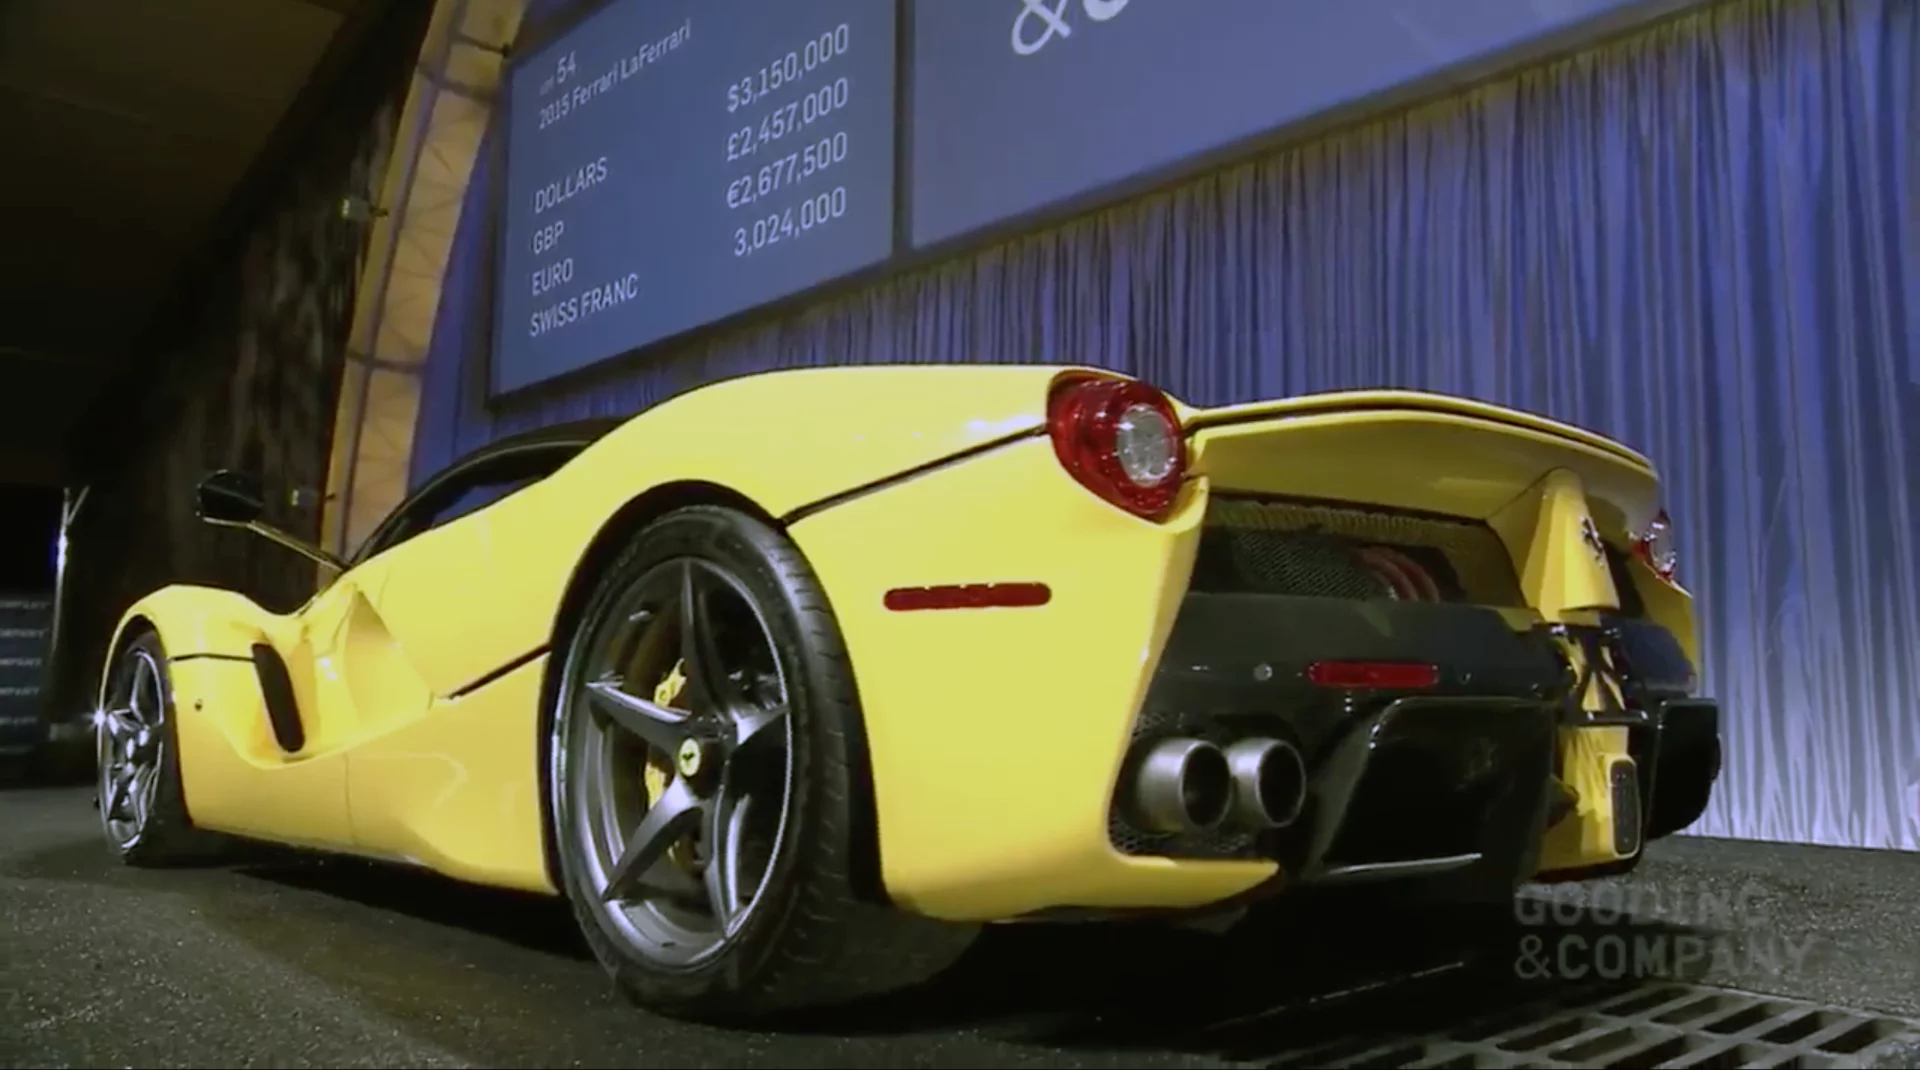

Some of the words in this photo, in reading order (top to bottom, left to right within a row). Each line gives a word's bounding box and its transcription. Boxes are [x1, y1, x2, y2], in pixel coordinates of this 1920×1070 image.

[556, 51, 577, 84] 54
[572, 62, 619, 110] Ferrari
[621, 19, 692, 81] LaFerrari
[727, 23, 851, 113] $3,150,000
[727, 77, 849, 162] £2,457,000
[534, 156, 608, 214] DOLLARS
[727, 131, 848, 209] €2,677,500
[532, 220, 565, 255] GBP
[734, 186, 847, 257] 3,024,000
[529, 297, 579, 338] SWISS
[581, 272, 640, 320] FRANC
[532, 257, 574, 297] EURO
